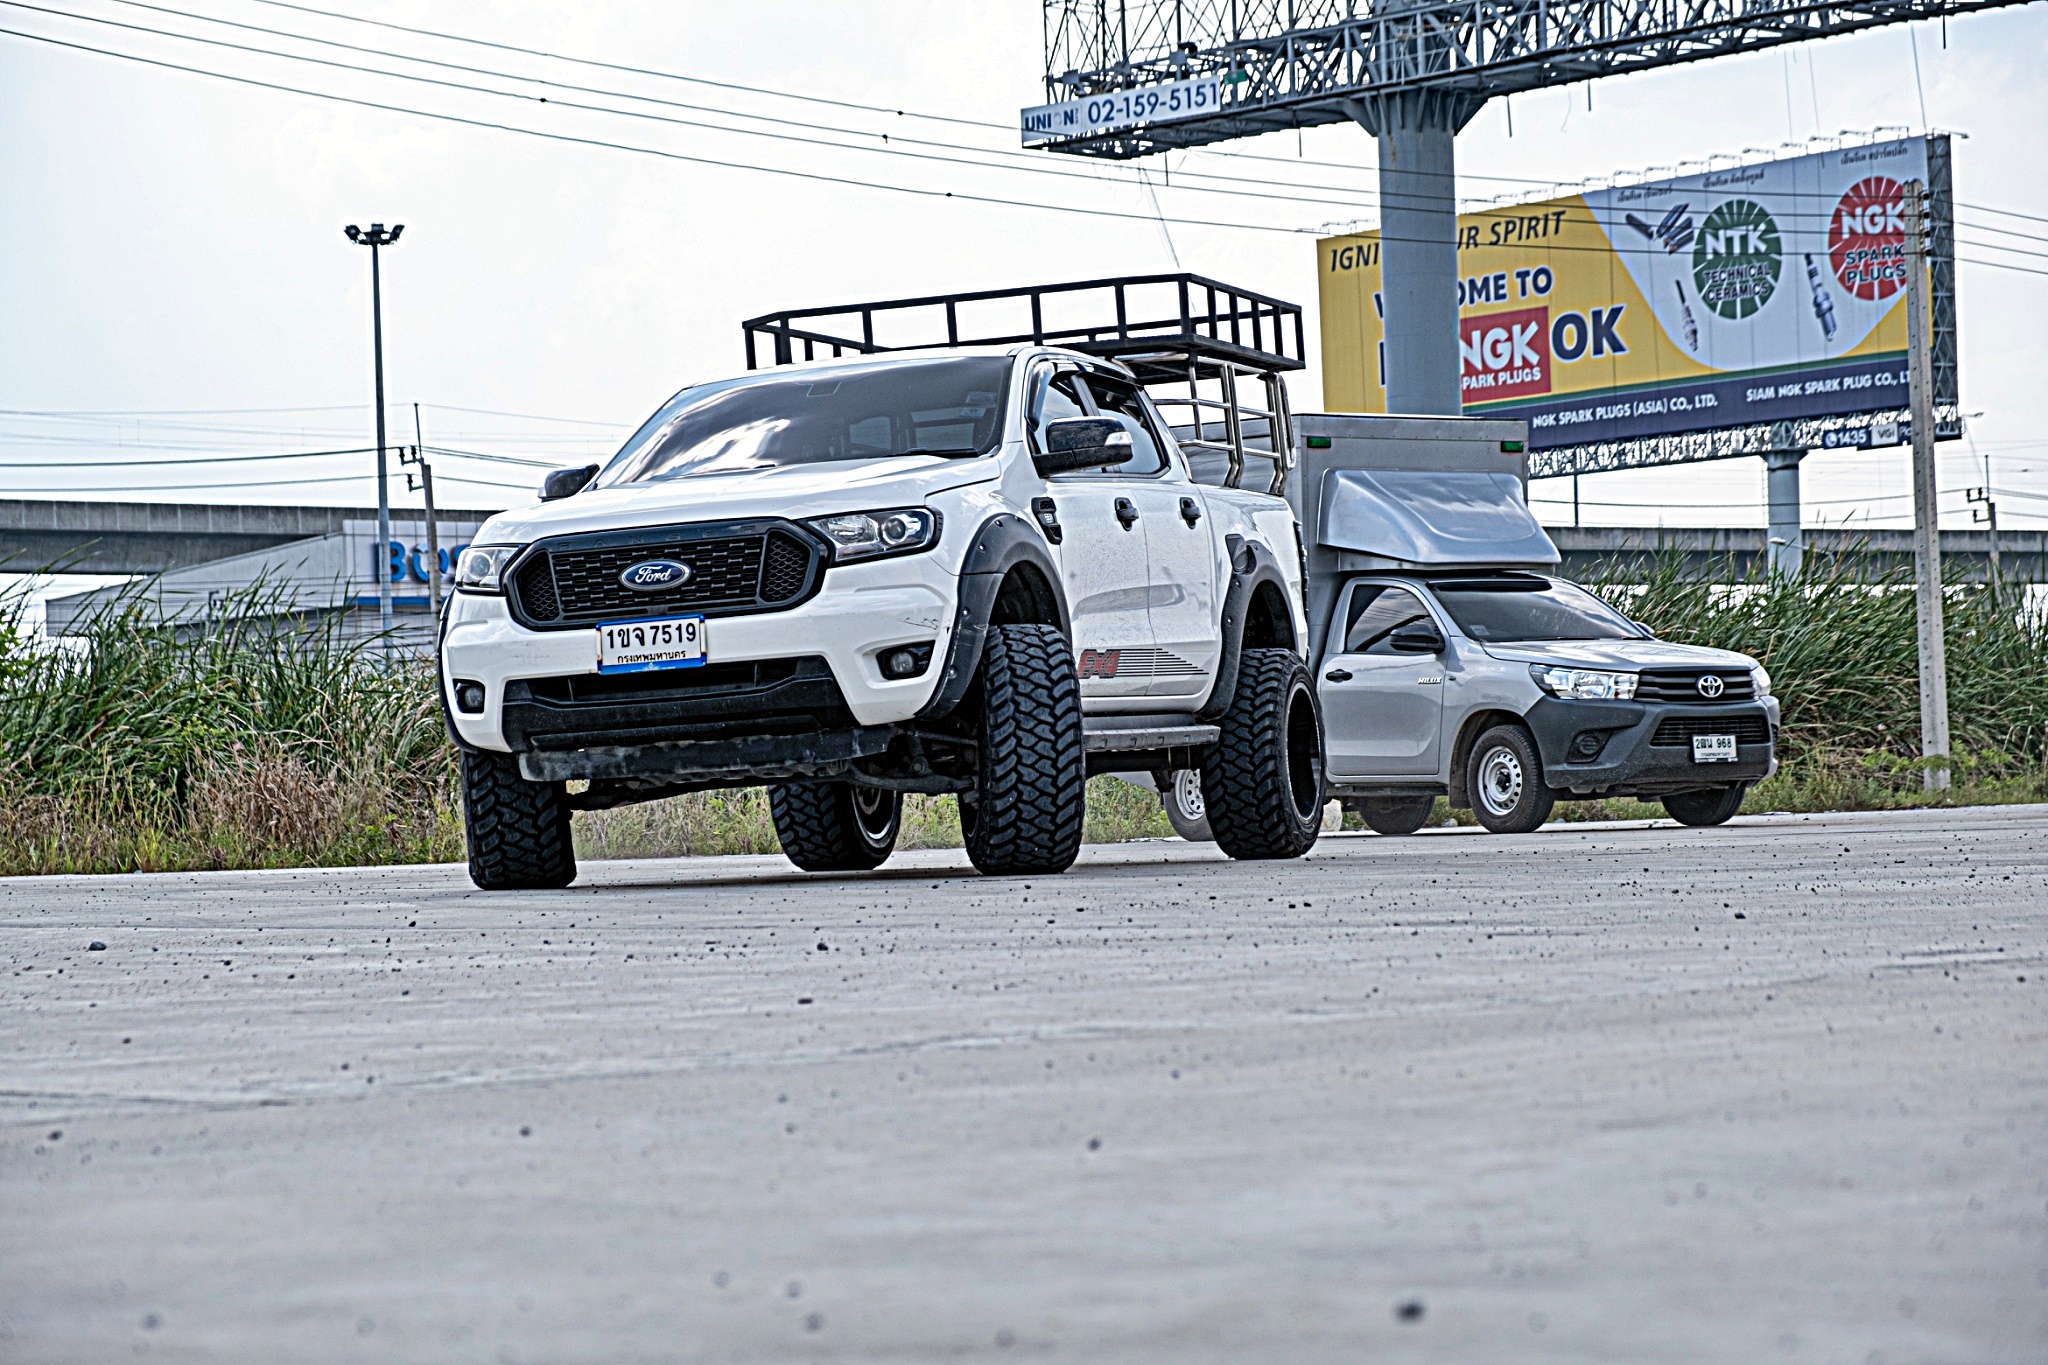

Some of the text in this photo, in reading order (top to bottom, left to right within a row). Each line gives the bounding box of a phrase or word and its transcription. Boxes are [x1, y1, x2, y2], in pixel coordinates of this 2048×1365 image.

[1088, 83, 1217, 123] 02-159-5151
[1841, 201, 1904, 239] NGK
[1331, 242, 1379, 272] IGNI
[1489, 210, 1566, 245] SPIRIT
[1705, 222, 1767, 260] NTK
[1845, 244, 1904, 265] SPARK
[1516, 266, 1553, 297] TO
[1703, 262, 1772, 283] TECHNICAL
[1846, 263, 1906, 284] PLUGS
[1706, 281, 1770, 302] CERAMICS
[1460, 321, 1540, 374] NGK
[1552, 305, 1627, 362] OK
[1461, 366, 1541, 389] PARK PLUGS
[1746, 386, 1775, 402] SIAM
[1778, 383, 1802, 398] NGK
[1804, 378, 1840, 395] SPARK
[1843, 373, 1871, 390] PLUG
[1874, 371, 1898, 386] CO.,
[1533, 393, 1718, 428] NGK SPARK PLUGS (ASIA) CO., LTD.
[1838, 429, 1866, 445] 1435
[635, 565, 672, 584] Ford
[607, 622, 696, 649] 1ขจ 7519
[1077, 649, 1121, 679] FX4
[1717, 737, 1731, 748] 968
